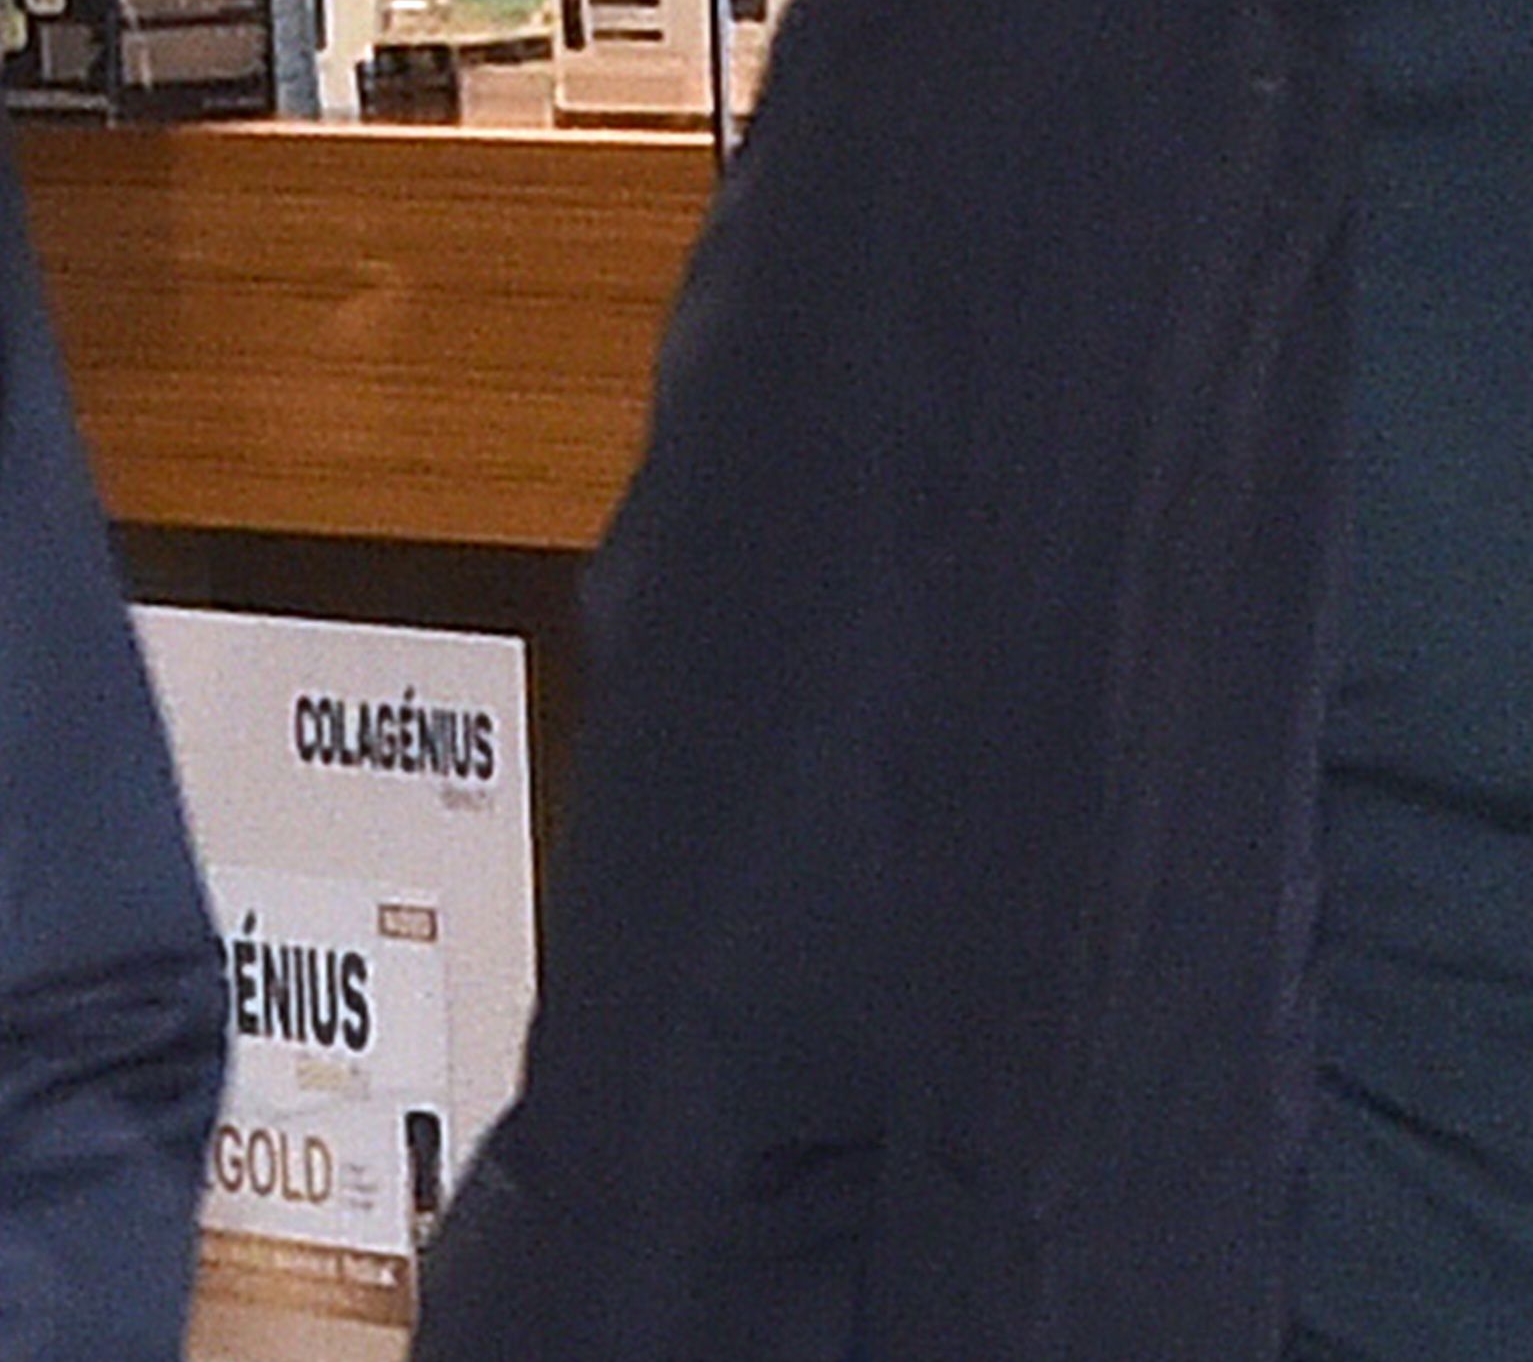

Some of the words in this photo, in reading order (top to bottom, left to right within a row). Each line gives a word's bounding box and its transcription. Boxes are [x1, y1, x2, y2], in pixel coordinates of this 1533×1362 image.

[295, 684, 494, 781] COLAGÉNIUS
[216, 908, 371, 1052] ÉNIUS
[213, 1123, 333, 1206] GOLD
